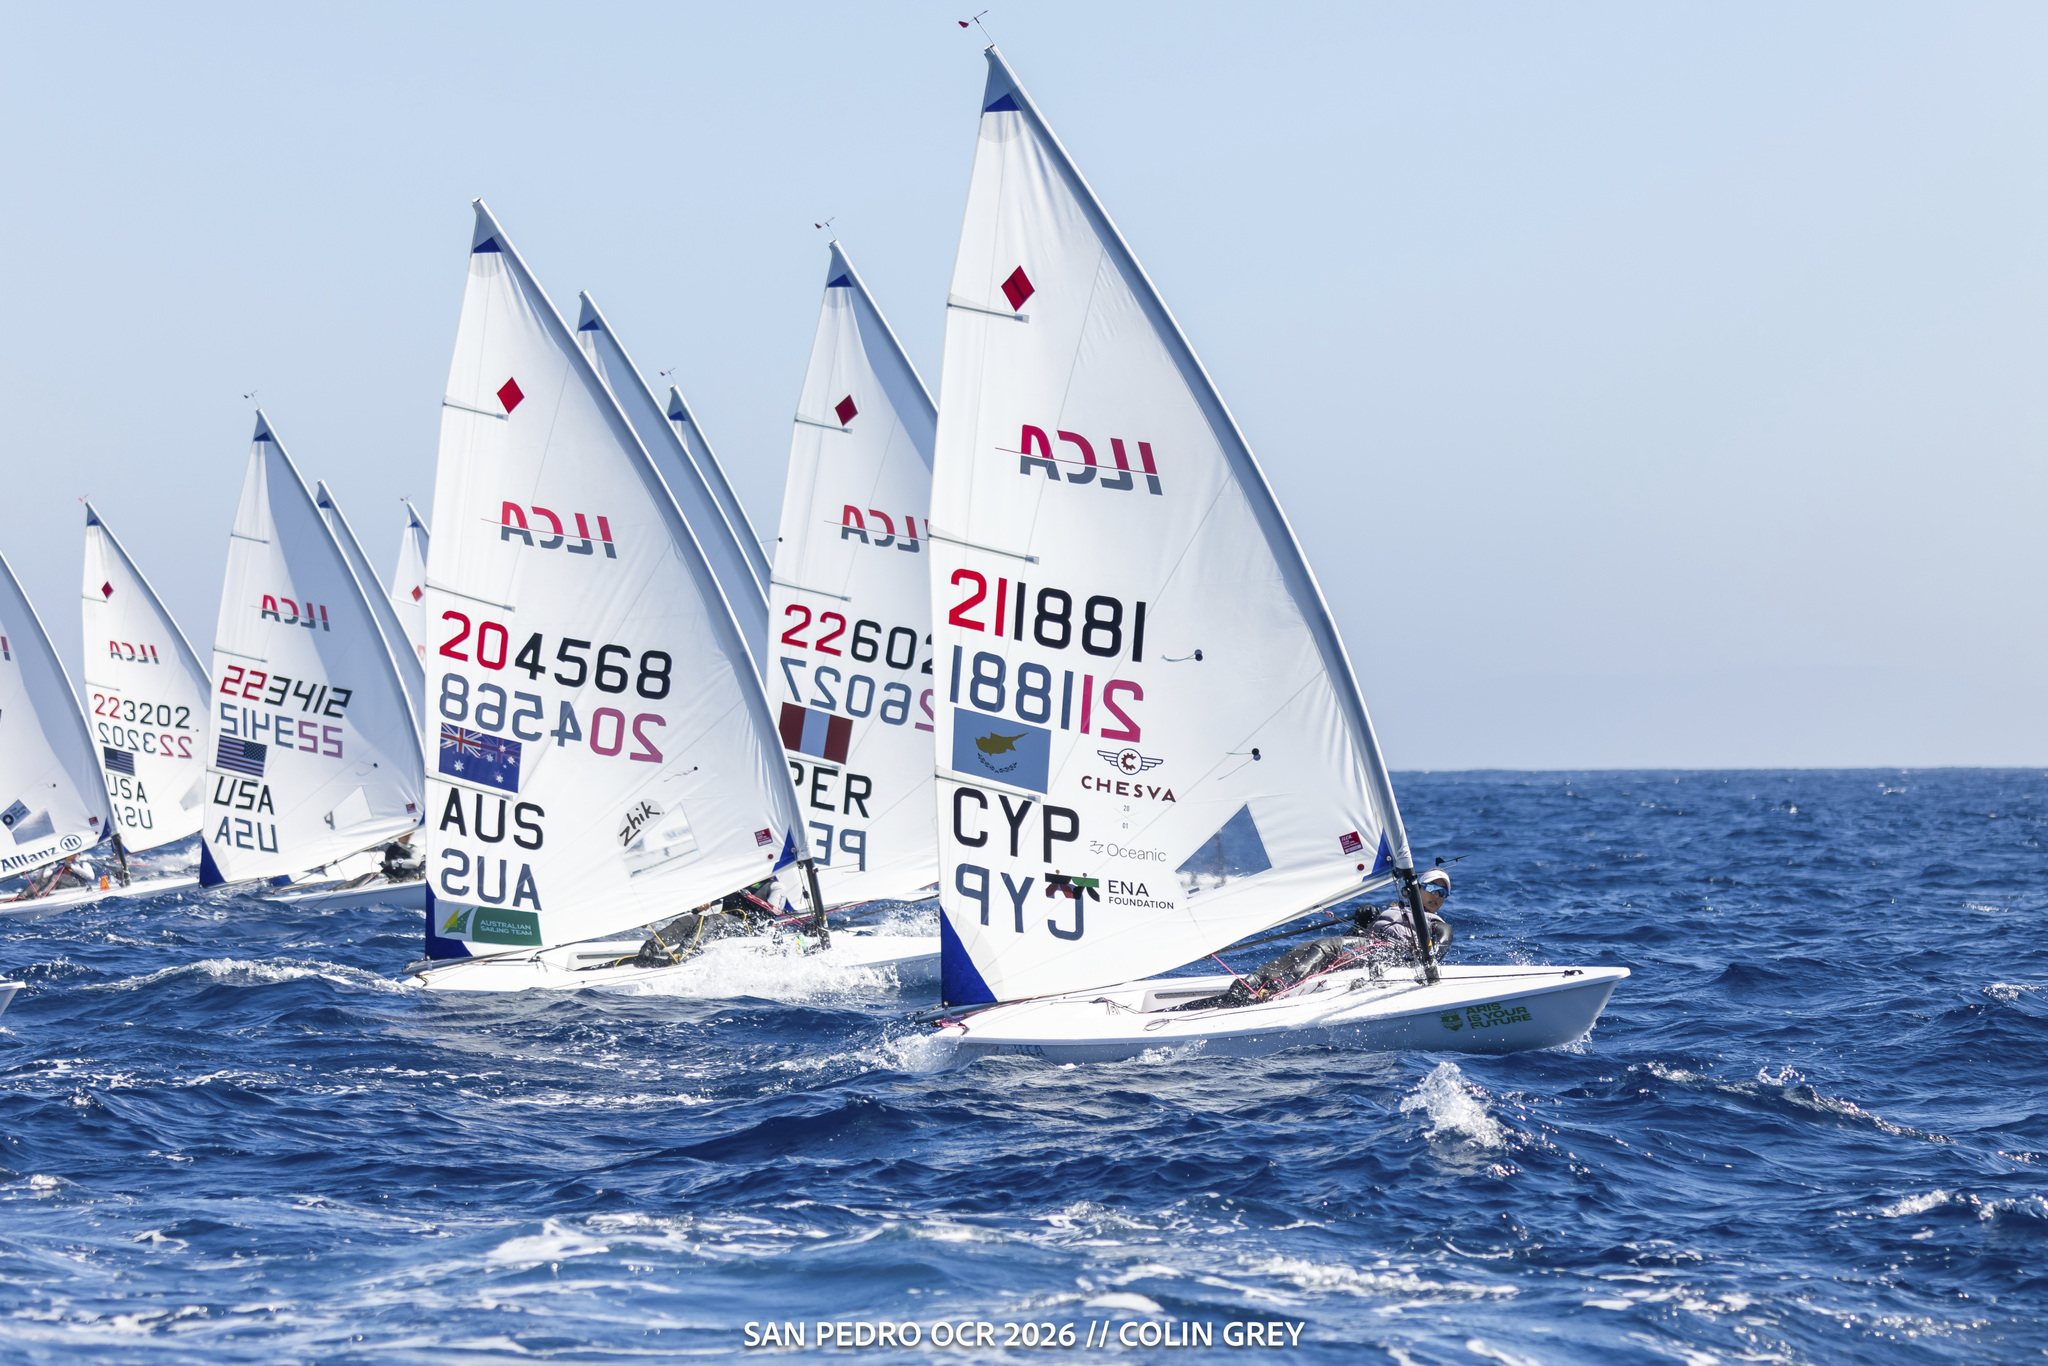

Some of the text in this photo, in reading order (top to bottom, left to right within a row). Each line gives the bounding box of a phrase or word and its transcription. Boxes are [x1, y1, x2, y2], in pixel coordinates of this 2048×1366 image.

[948, 568, 1146, 662] 211881
[781, 604, 933, 675] 2260
[439, 610, 672, 700] 204568
[220, 665, 353, 719] 223412
[94, 693, 190, 729] 223202
[106, 774, 148, 803] USA
[213, 776, 275, 815] USA
[1081, 775, 1176, 803] CHESVA
[439, 787, 545, 850] AUS
[953, 787, 1080, 863] CYP
[0, 847, 59, 872] Allianz
[1106, 843, 1167, 862] Oceanic
[1108, 879, 1150, 897] ENA
[1108, 896, 1175, 910] FOUNDATION
[480, 919, 531, 930] AUSTRALIAN
[480, 926, 533, 936] SAILING TEAM
[1466, 1002, 1502, 1015] ARIS
[1466, 1013, 1482, 1023] IS
[1482, 1006, 1528, 1020] YOUR
[1469, 1012, 1533, 1030] FUTURE
